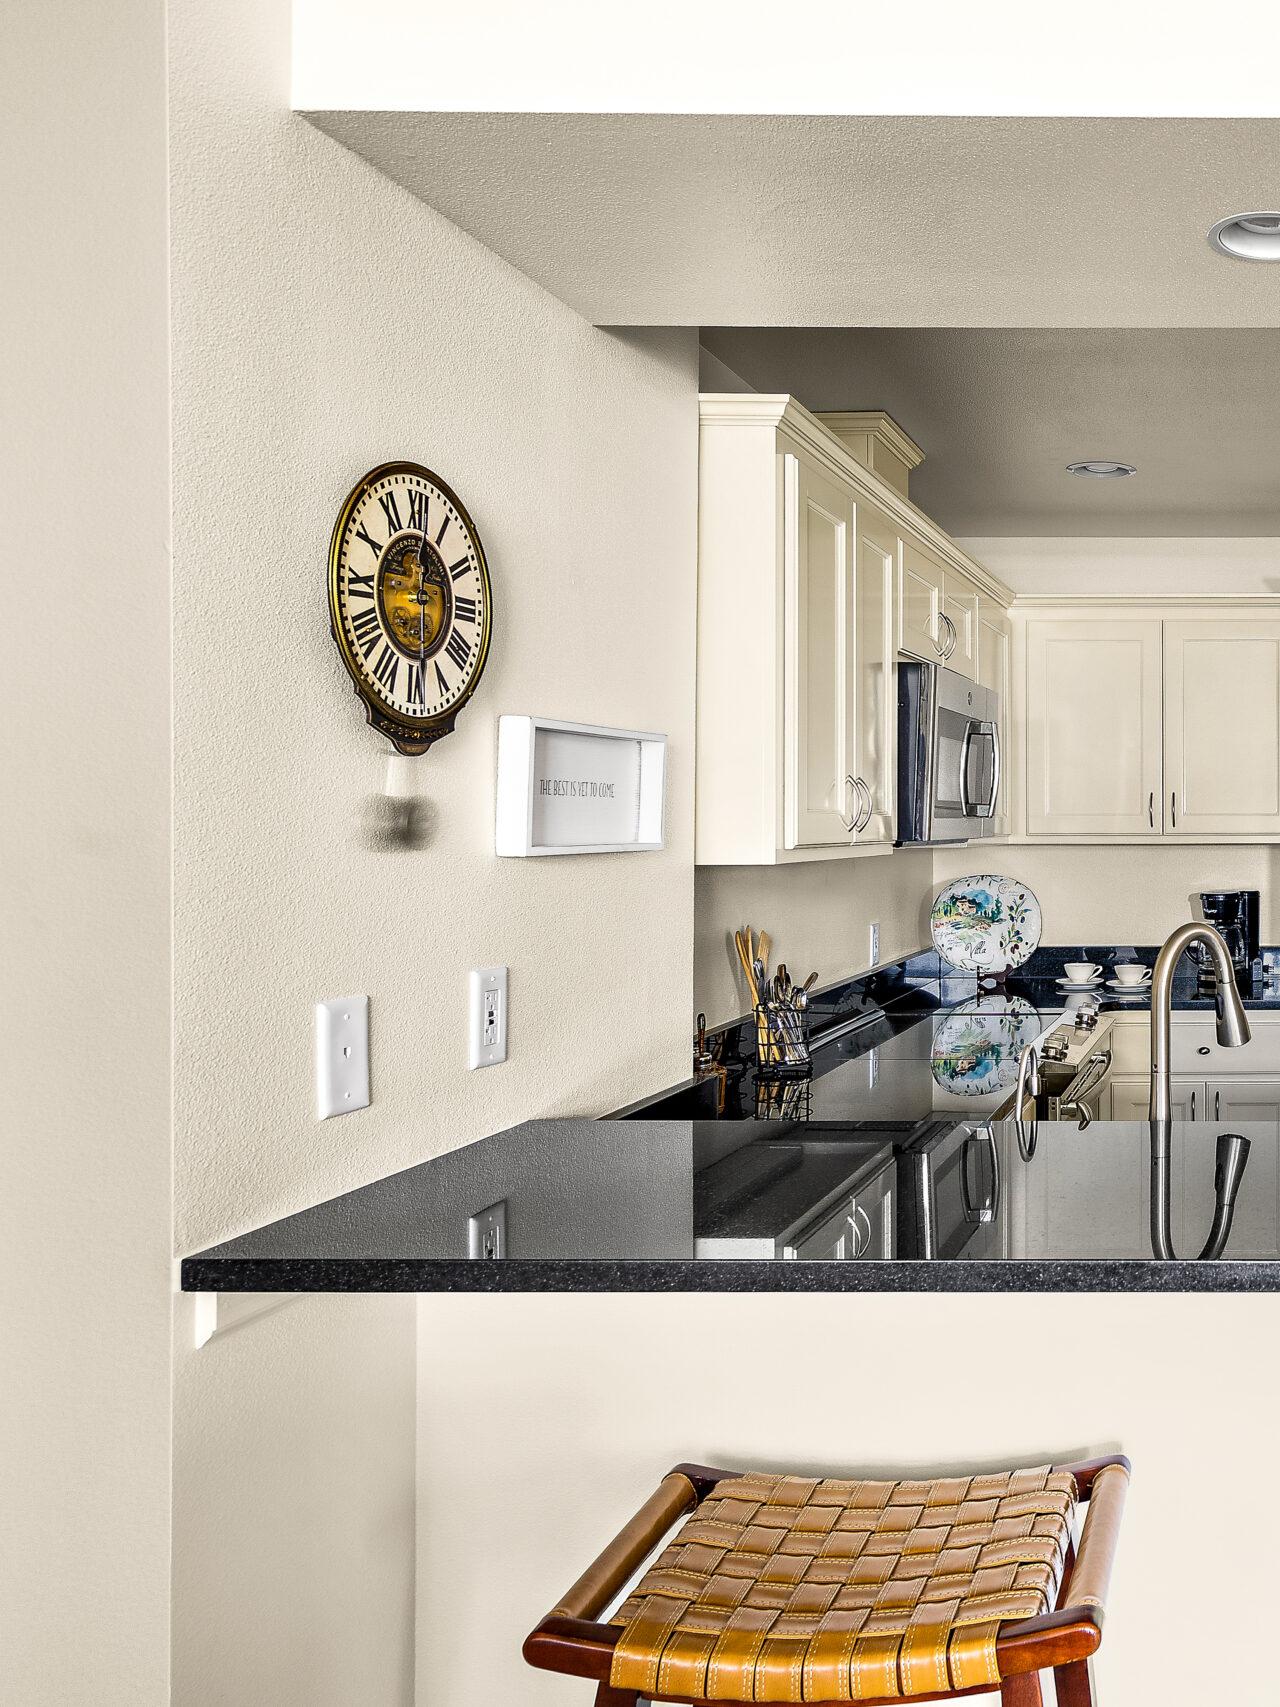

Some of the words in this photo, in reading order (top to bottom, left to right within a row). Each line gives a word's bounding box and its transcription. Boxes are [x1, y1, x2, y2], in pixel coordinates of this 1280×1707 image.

[378, 491, 404, 538] XI
[407, 489, 430, 535] XII
[435, 513, 452, 548] I
[355, 520, 383, 560] X
[387, 539, 416, 560] VINCENZO
[348, 565, 375, 600] IX
[449, 554, 473, 583] II
[455, 595, 476, 624] III
[351, 606, 384, 662] VIII
[371, 640, 400, 696] VII
[434, 660, 451, 699] V
[540, 779, 552, 796] THE
[553, 779, 569, 797] BEST
[570, 780, 577, 797] IS
[577, 781, 589, 797] YET
[590, 782, 598, 798] TO
[598, 782, 615, 799] COME
